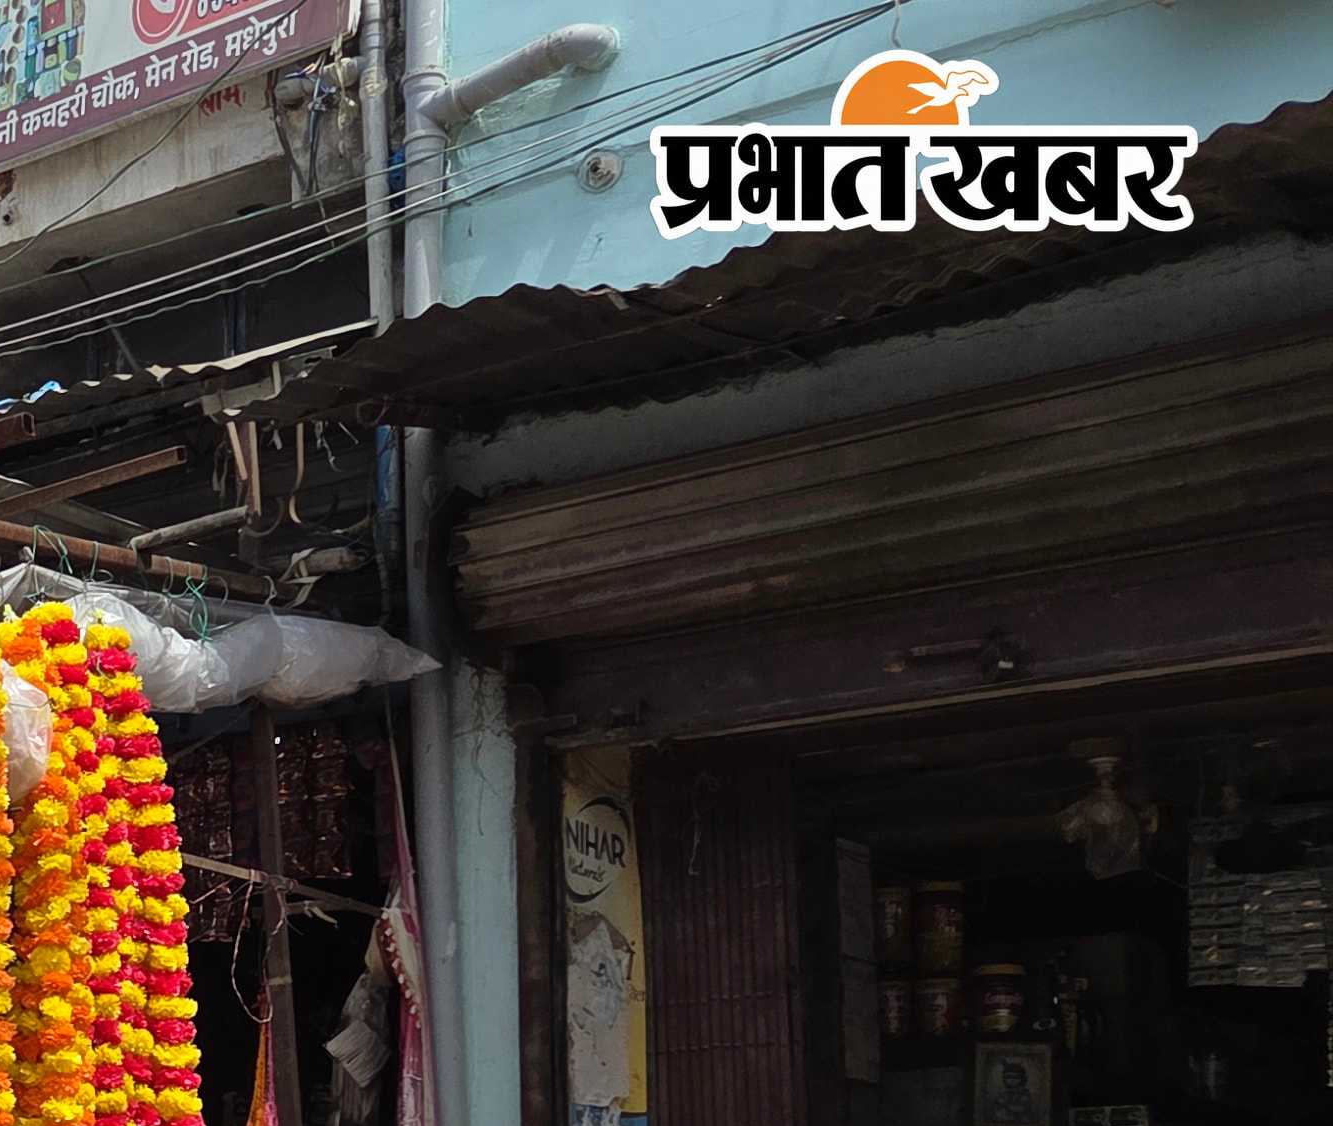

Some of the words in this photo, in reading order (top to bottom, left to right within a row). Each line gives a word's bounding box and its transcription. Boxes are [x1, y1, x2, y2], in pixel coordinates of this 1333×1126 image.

[21, 80, 88, 137] कचहरी
[145, 53, 179, 88] मेन
[566, 817, 625, 868] NIHAR
